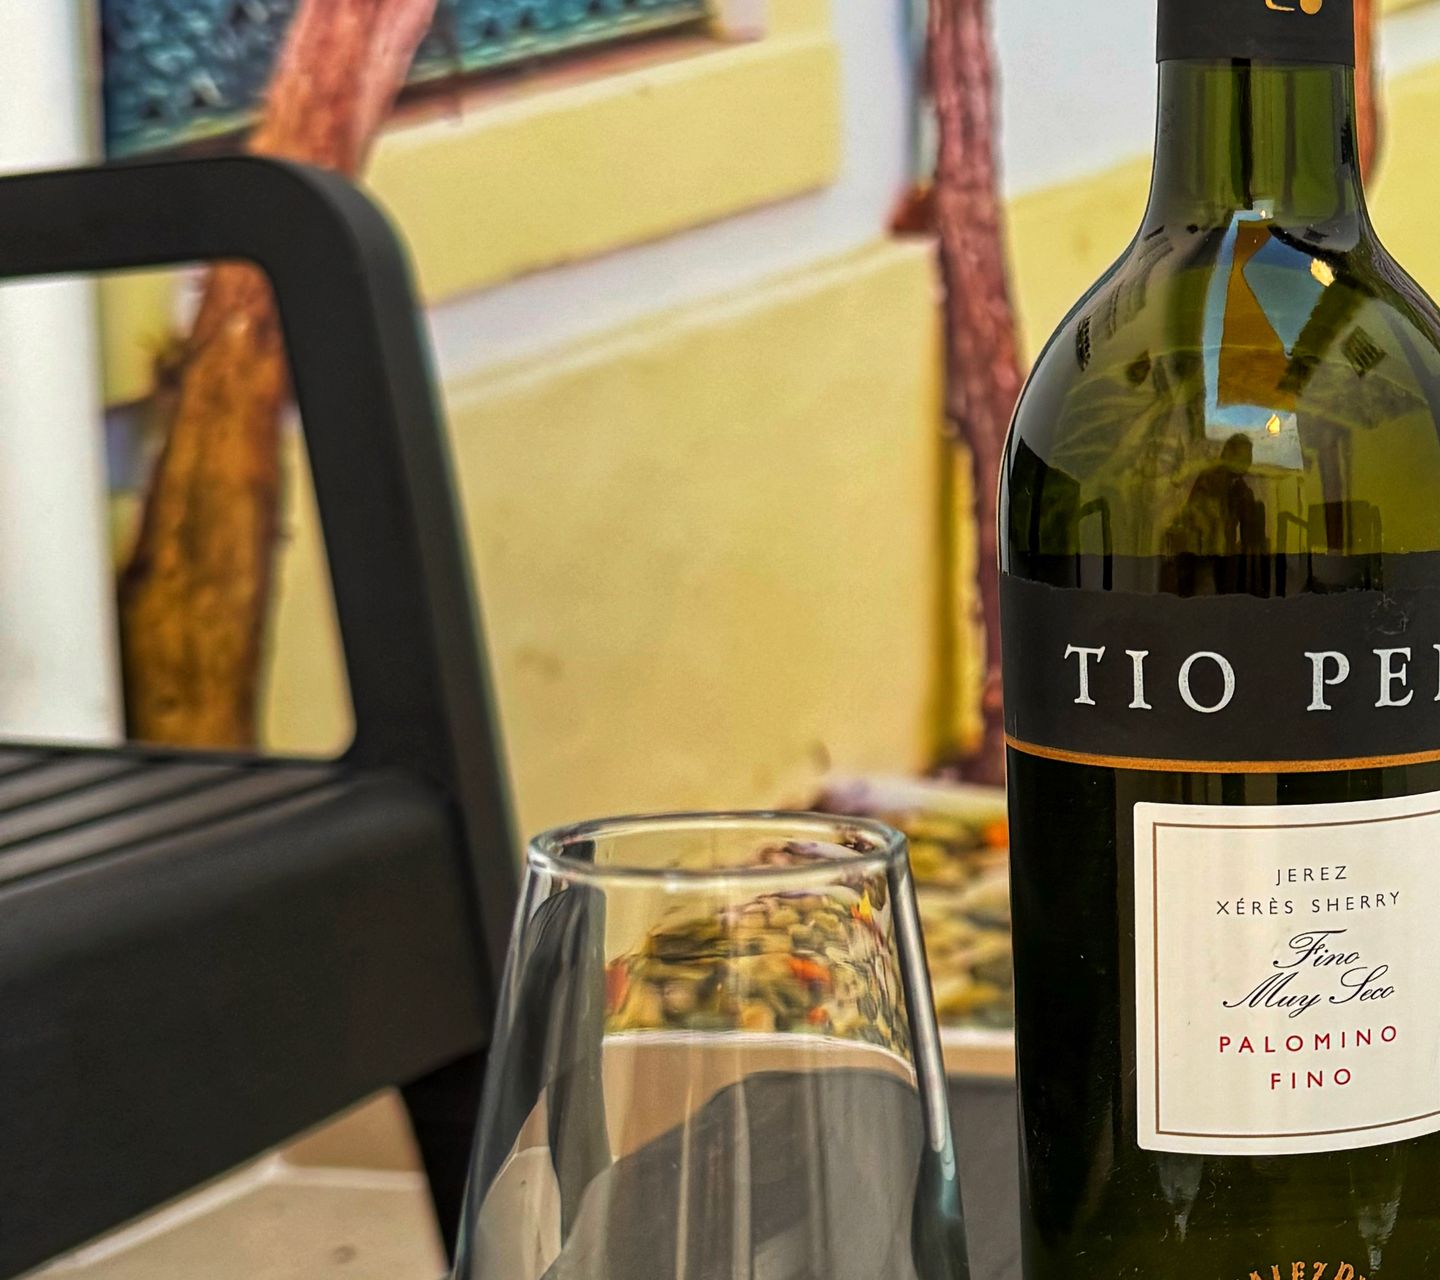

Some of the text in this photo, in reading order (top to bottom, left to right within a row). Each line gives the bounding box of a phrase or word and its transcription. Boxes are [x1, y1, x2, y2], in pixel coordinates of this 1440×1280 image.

[1064, 643, 1235, 714] TIO
[1275, 865, 1348, 886] JEREZ
[1216, 891, 1401, 915] XÉRÈS SHERRY
[1273, 928, 1360, 969] Fino
[1223, 964, 1395, 1019] Muy Seco
[1219, 1025, 1397, 1053] PALOMINO
[1270, 1068, 1352, 1090] FINO
